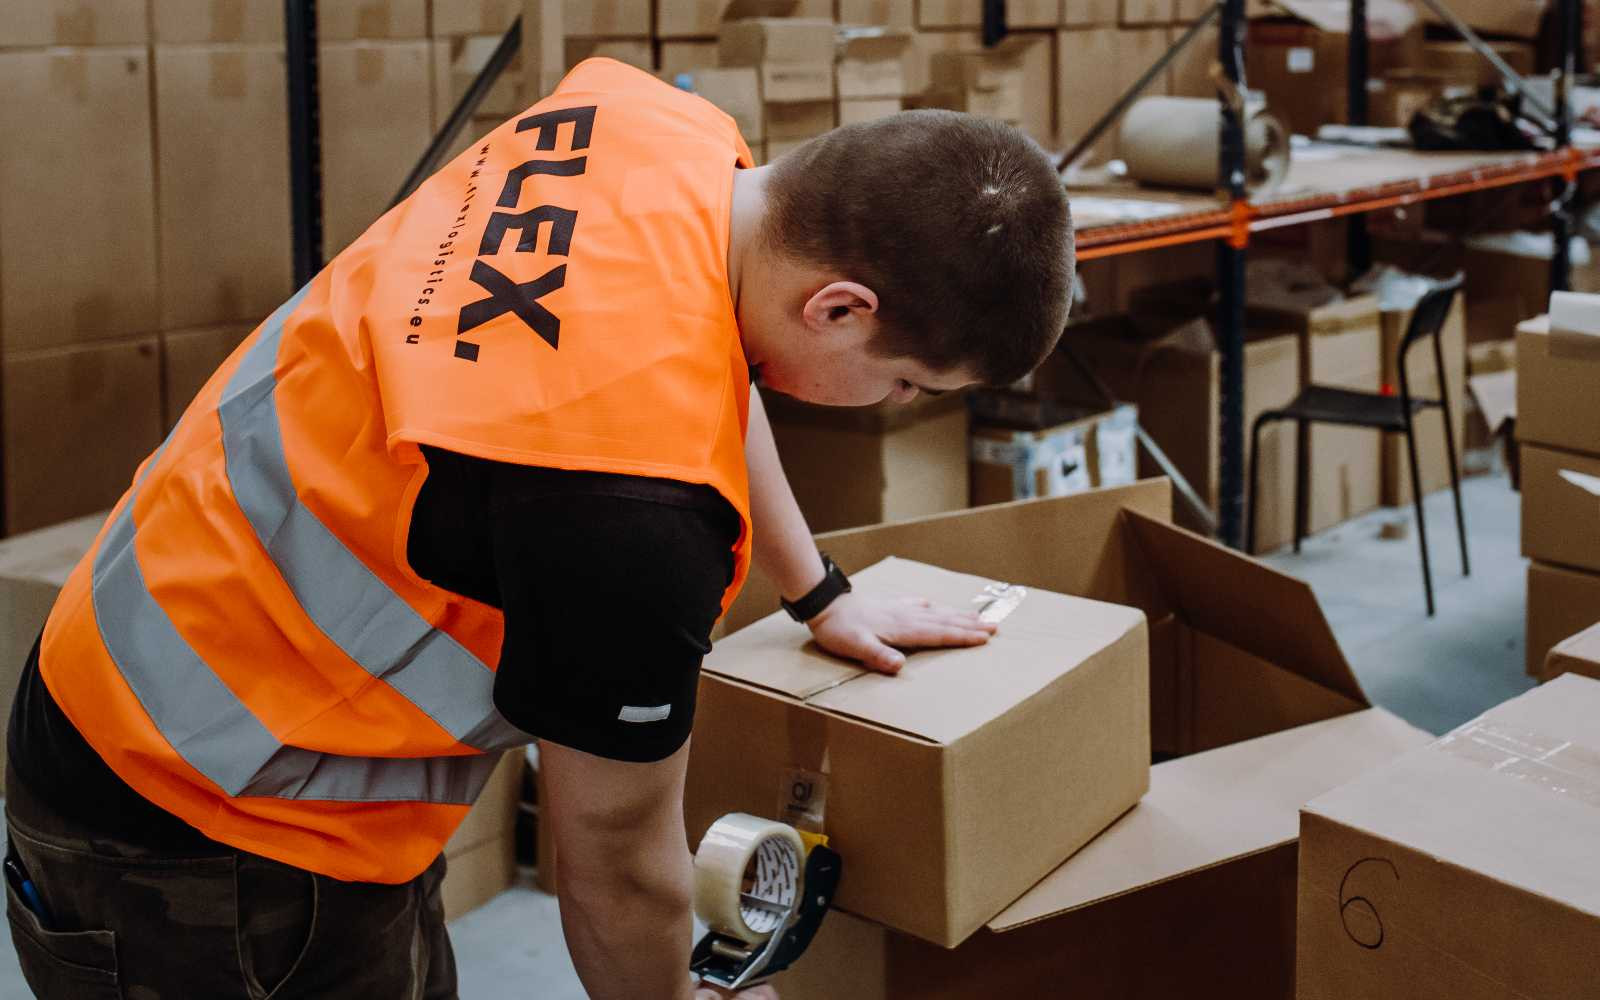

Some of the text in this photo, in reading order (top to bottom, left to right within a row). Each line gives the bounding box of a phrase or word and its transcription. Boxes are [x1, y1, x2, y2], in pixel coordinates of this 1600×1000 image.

[405, 144, 490, 345] www.flexlogistics.eu
[454, 105, 597, 362] FLEX.
[1338, 857, 1400, 950] 6
